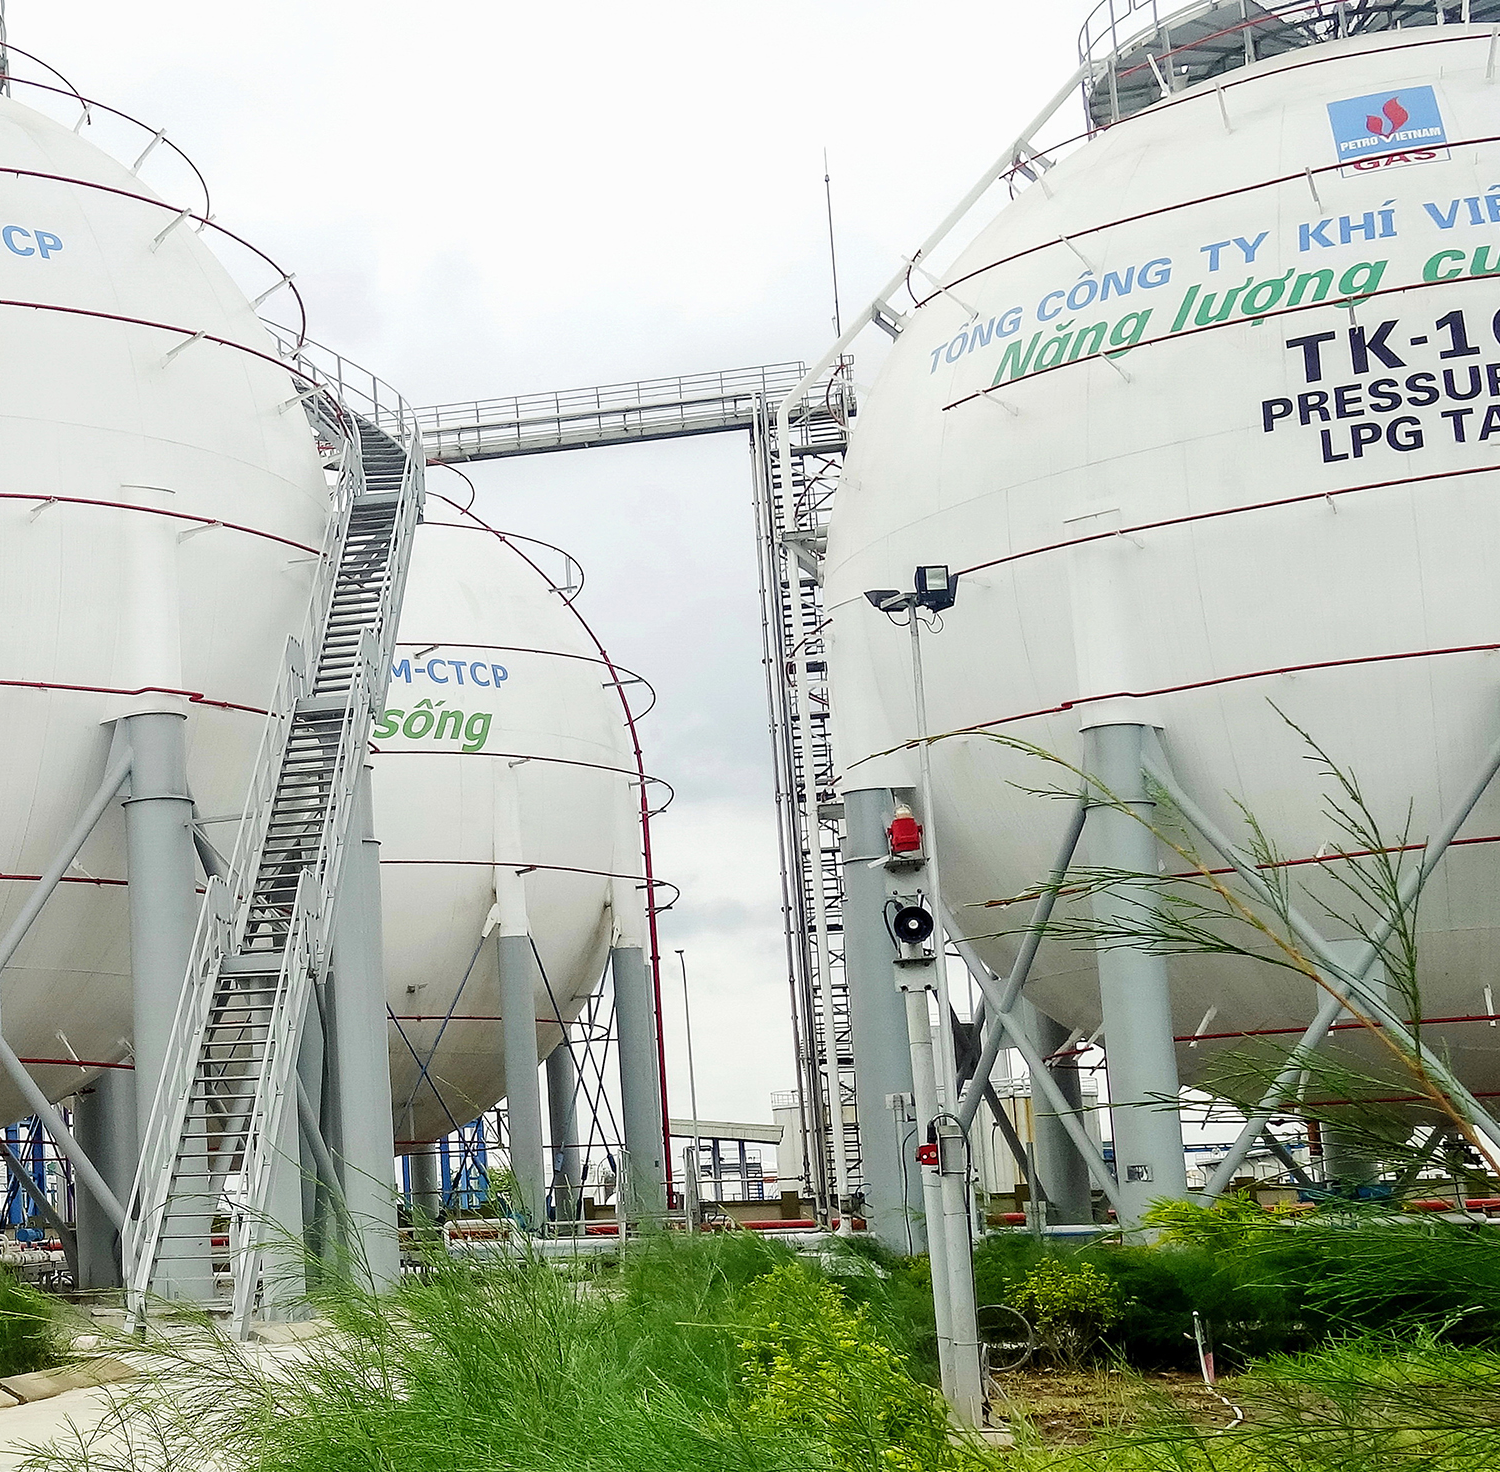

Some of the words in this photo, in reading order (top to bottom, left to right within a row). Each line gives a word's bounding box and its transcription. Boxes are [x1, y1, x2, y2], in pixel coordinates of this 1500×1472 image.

[1340, 127, 1442, 152] PETROVIETNAM
[1036, 257, 1173, 322] CÔNG
[1200, 230, 1270, 272] TY
[1299, 198, 1398, 253] KHÍ
[991, 308, 1154, 388] Năng
[1169, 260, 1389, 334] lượng
[1285, 309, 1500, 384] TK-1
[1320, 415, 1425, 464] LPG
[372, 698, 493, 752] sống
